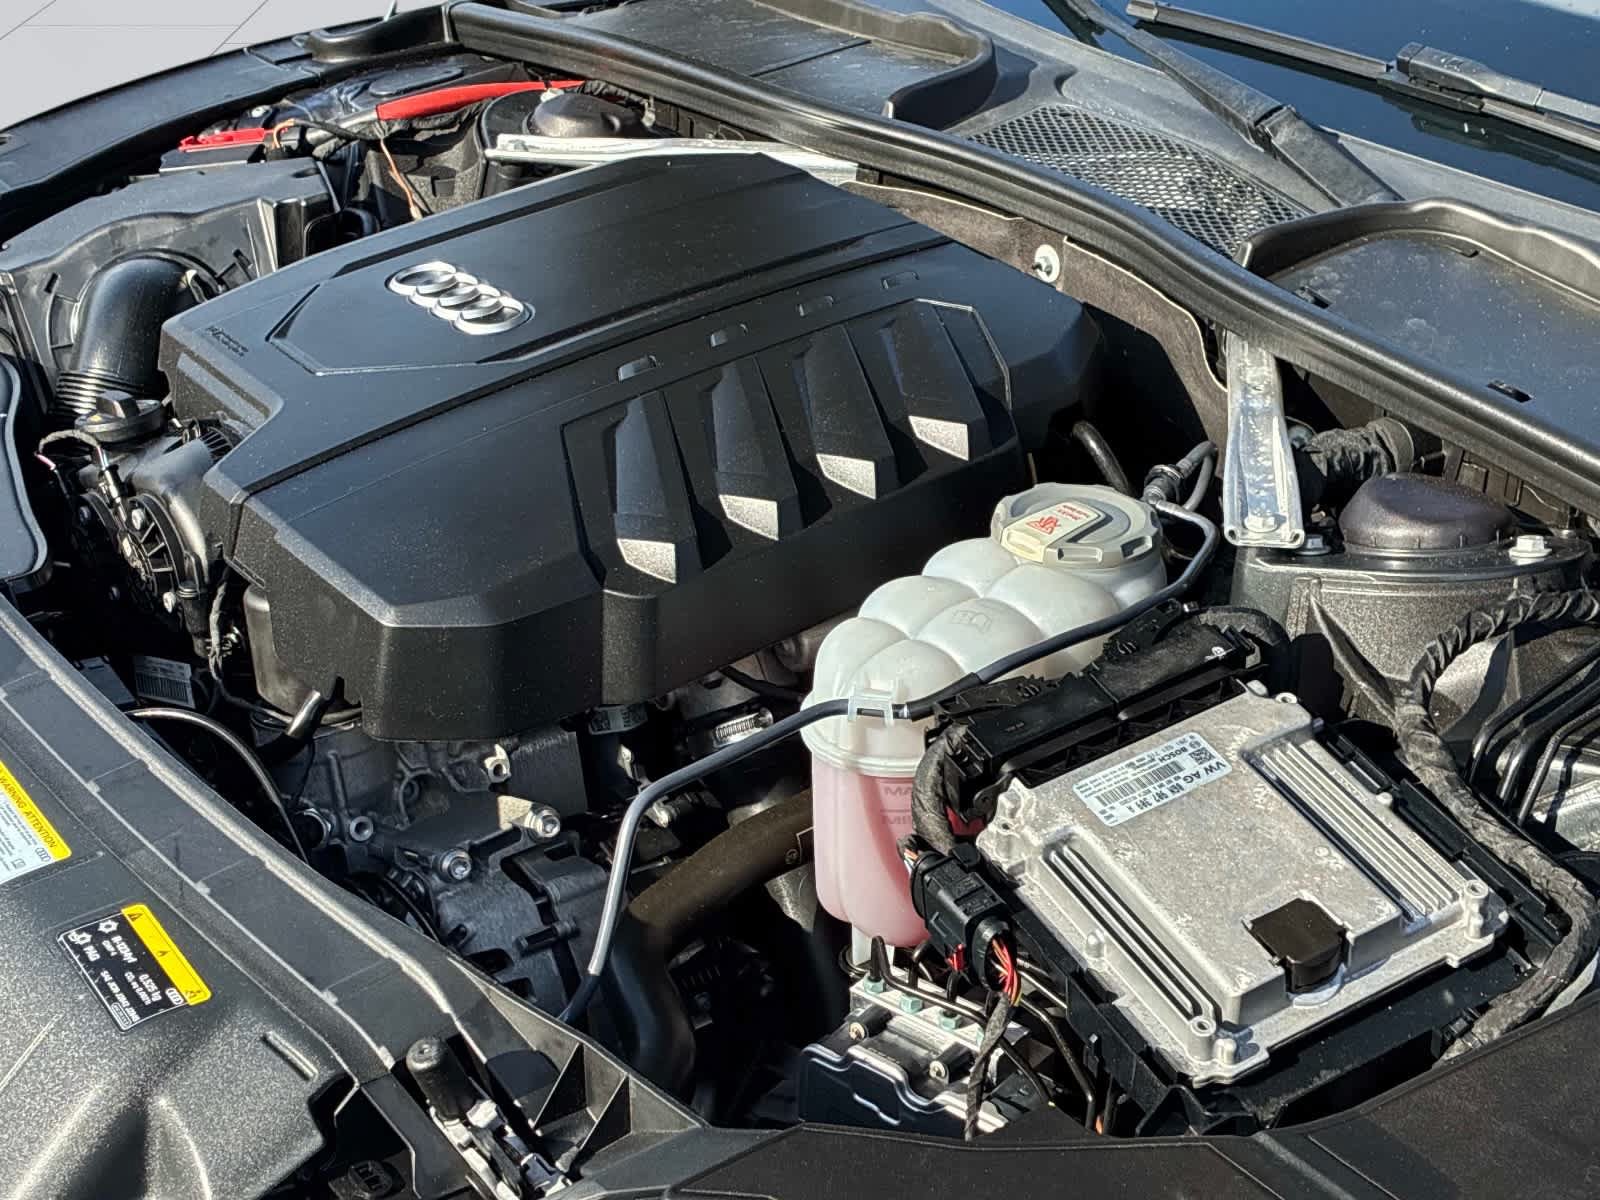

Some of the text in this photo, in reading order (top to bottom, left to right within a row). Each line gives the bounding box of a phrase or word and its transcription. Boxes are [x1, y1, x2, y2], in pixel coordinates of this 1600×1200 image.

[1158, 746, 1188, 763] BOSCH
[1204, 761, 1226, 775] VW
[1183, 771, 1201, 783] AG
[884, 786, 912, 796] MA
[24, 811, 56, 848] ATTENTION
[83, 945, 100, 962] PAG
[151, 990, 163, 1002] kg
